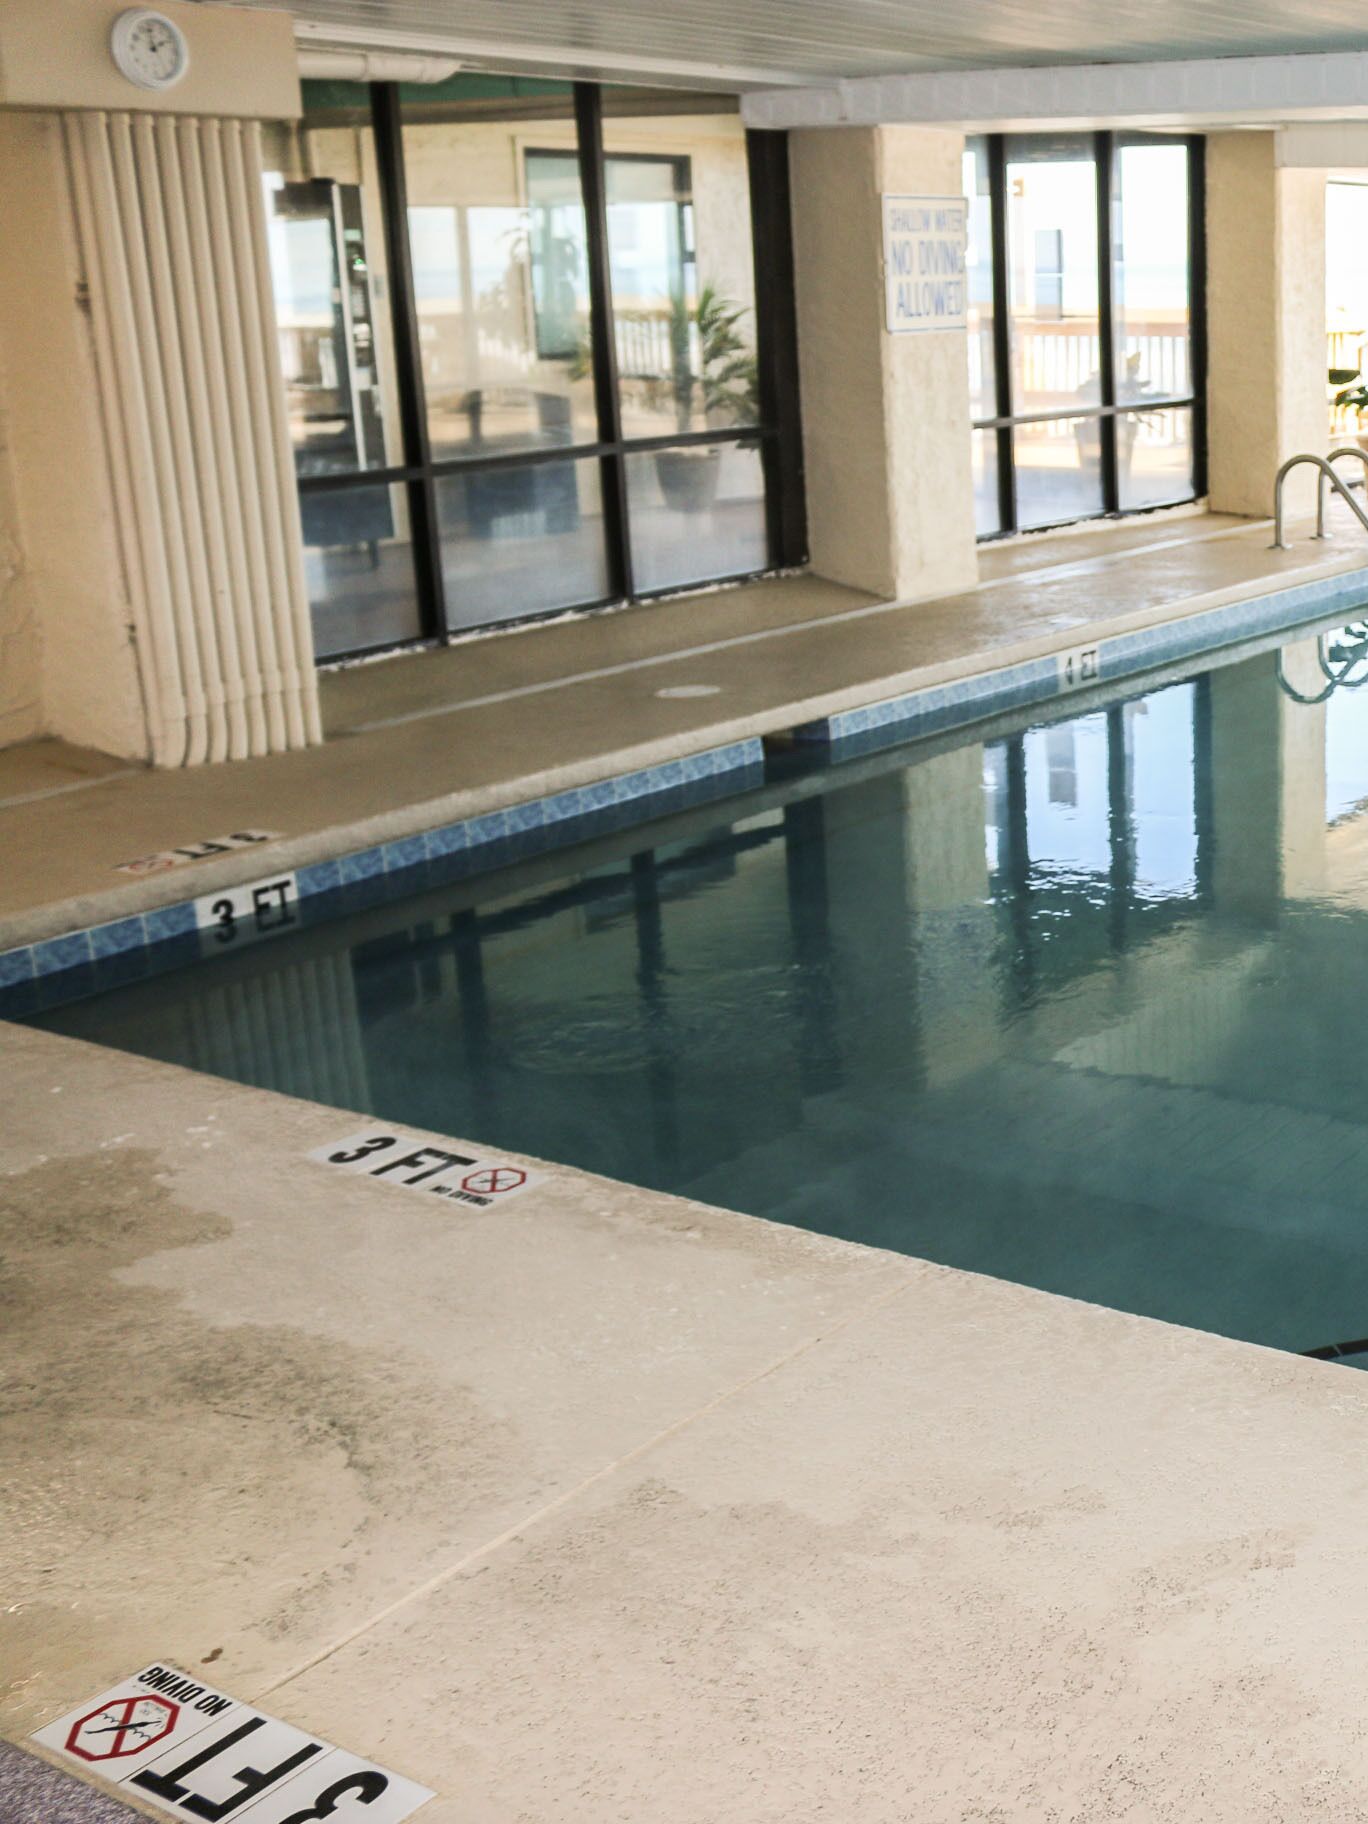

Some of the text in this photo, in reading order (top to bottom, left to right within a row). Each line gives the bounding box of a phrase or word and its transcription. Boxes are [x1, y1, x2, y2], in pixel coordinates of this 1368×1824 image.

[891, 240, 966, 276] NO DIVING
[896, 280, 963, 318] ALLOWED
[211, 879, 292, 925] 3 FT
[327, 1136, 479, 1186] 3 FT
[137, 1666, 233, 1717] NO DIVING
[129, 1716, 324, 1823] FT
